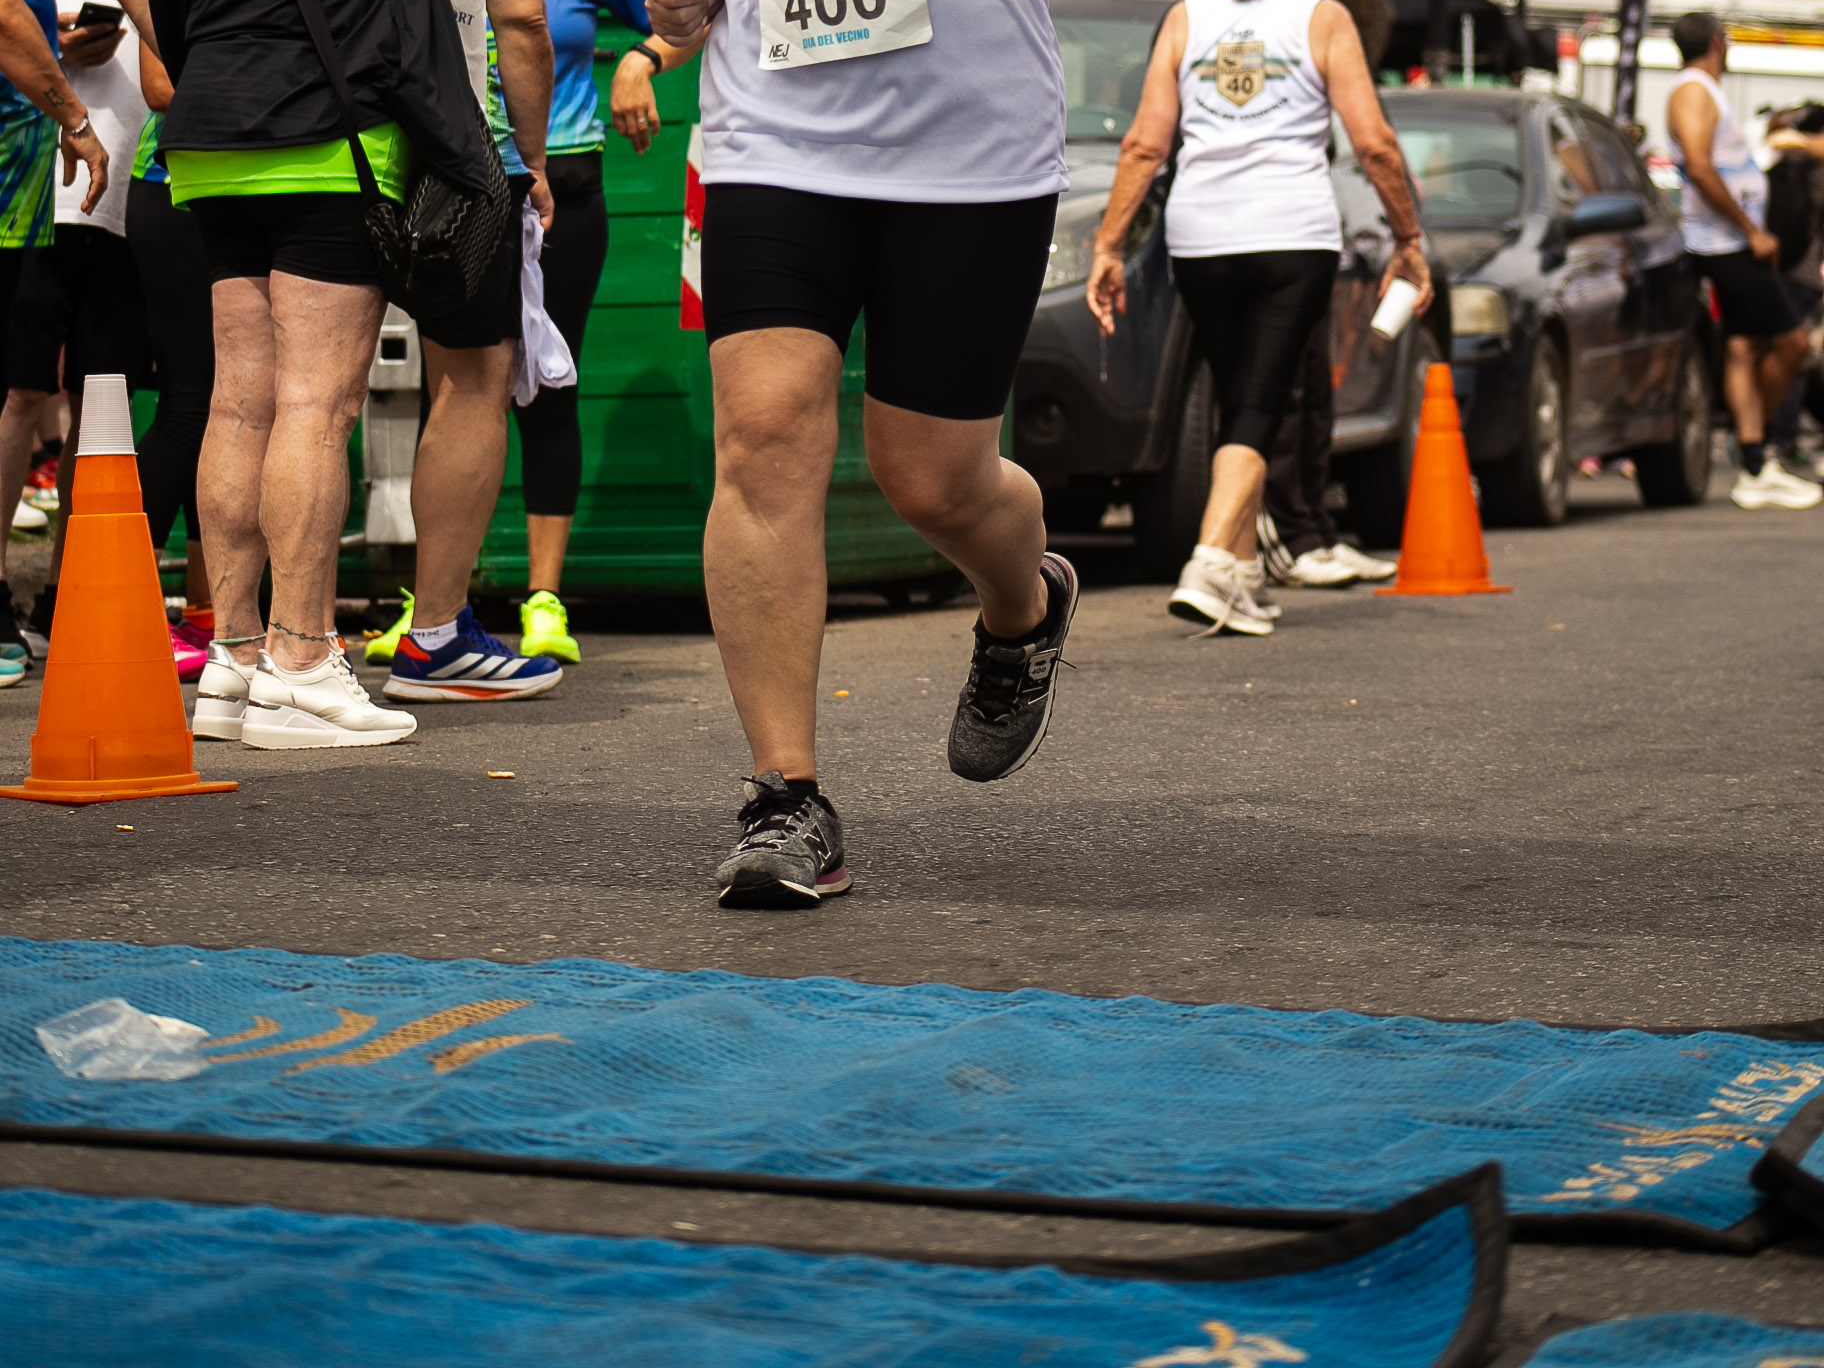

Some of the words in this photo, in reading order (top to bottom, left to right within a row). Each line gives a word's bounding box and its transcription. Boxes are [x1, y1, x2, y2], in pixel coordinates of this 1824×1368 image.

[802, 38, 817, 50] DIA
[817, 34, 834, 47] DEL
[835, 28, 870, 43] VECINO
[768, 43, 790, 59] NEJ
[1226, 77, 1254, 95] 40
[1031, 666, 1047, 675] 400
